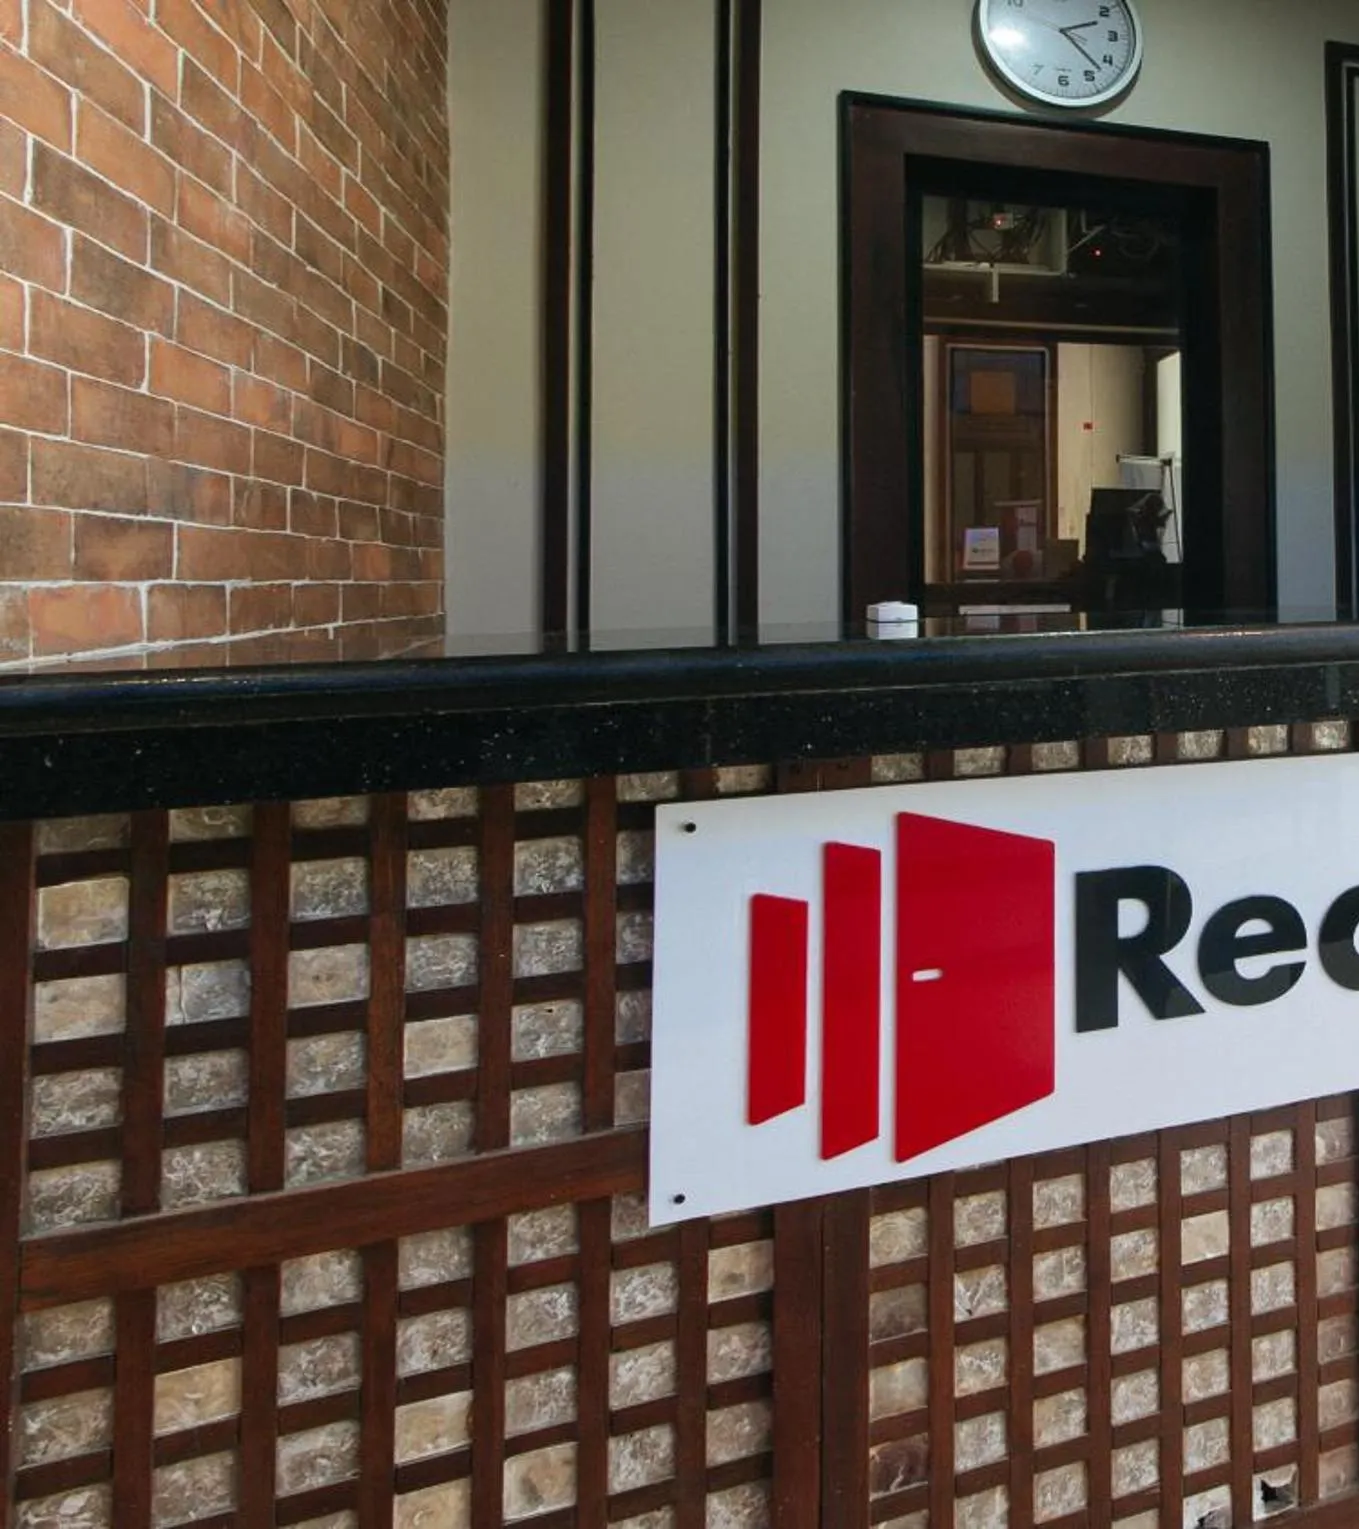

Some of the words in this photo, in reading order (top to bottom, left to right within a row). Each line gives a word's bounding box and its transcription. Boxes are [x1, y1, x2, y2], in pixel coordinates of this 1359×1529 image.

[1098, 6, 1110, 17] 2
[1108, 30, 1118, 42] 3
[1103, 54, 1113, 66] 4
[1058, 75, 1069, 87] 6
[1083, 70, 1095, 82] 5
